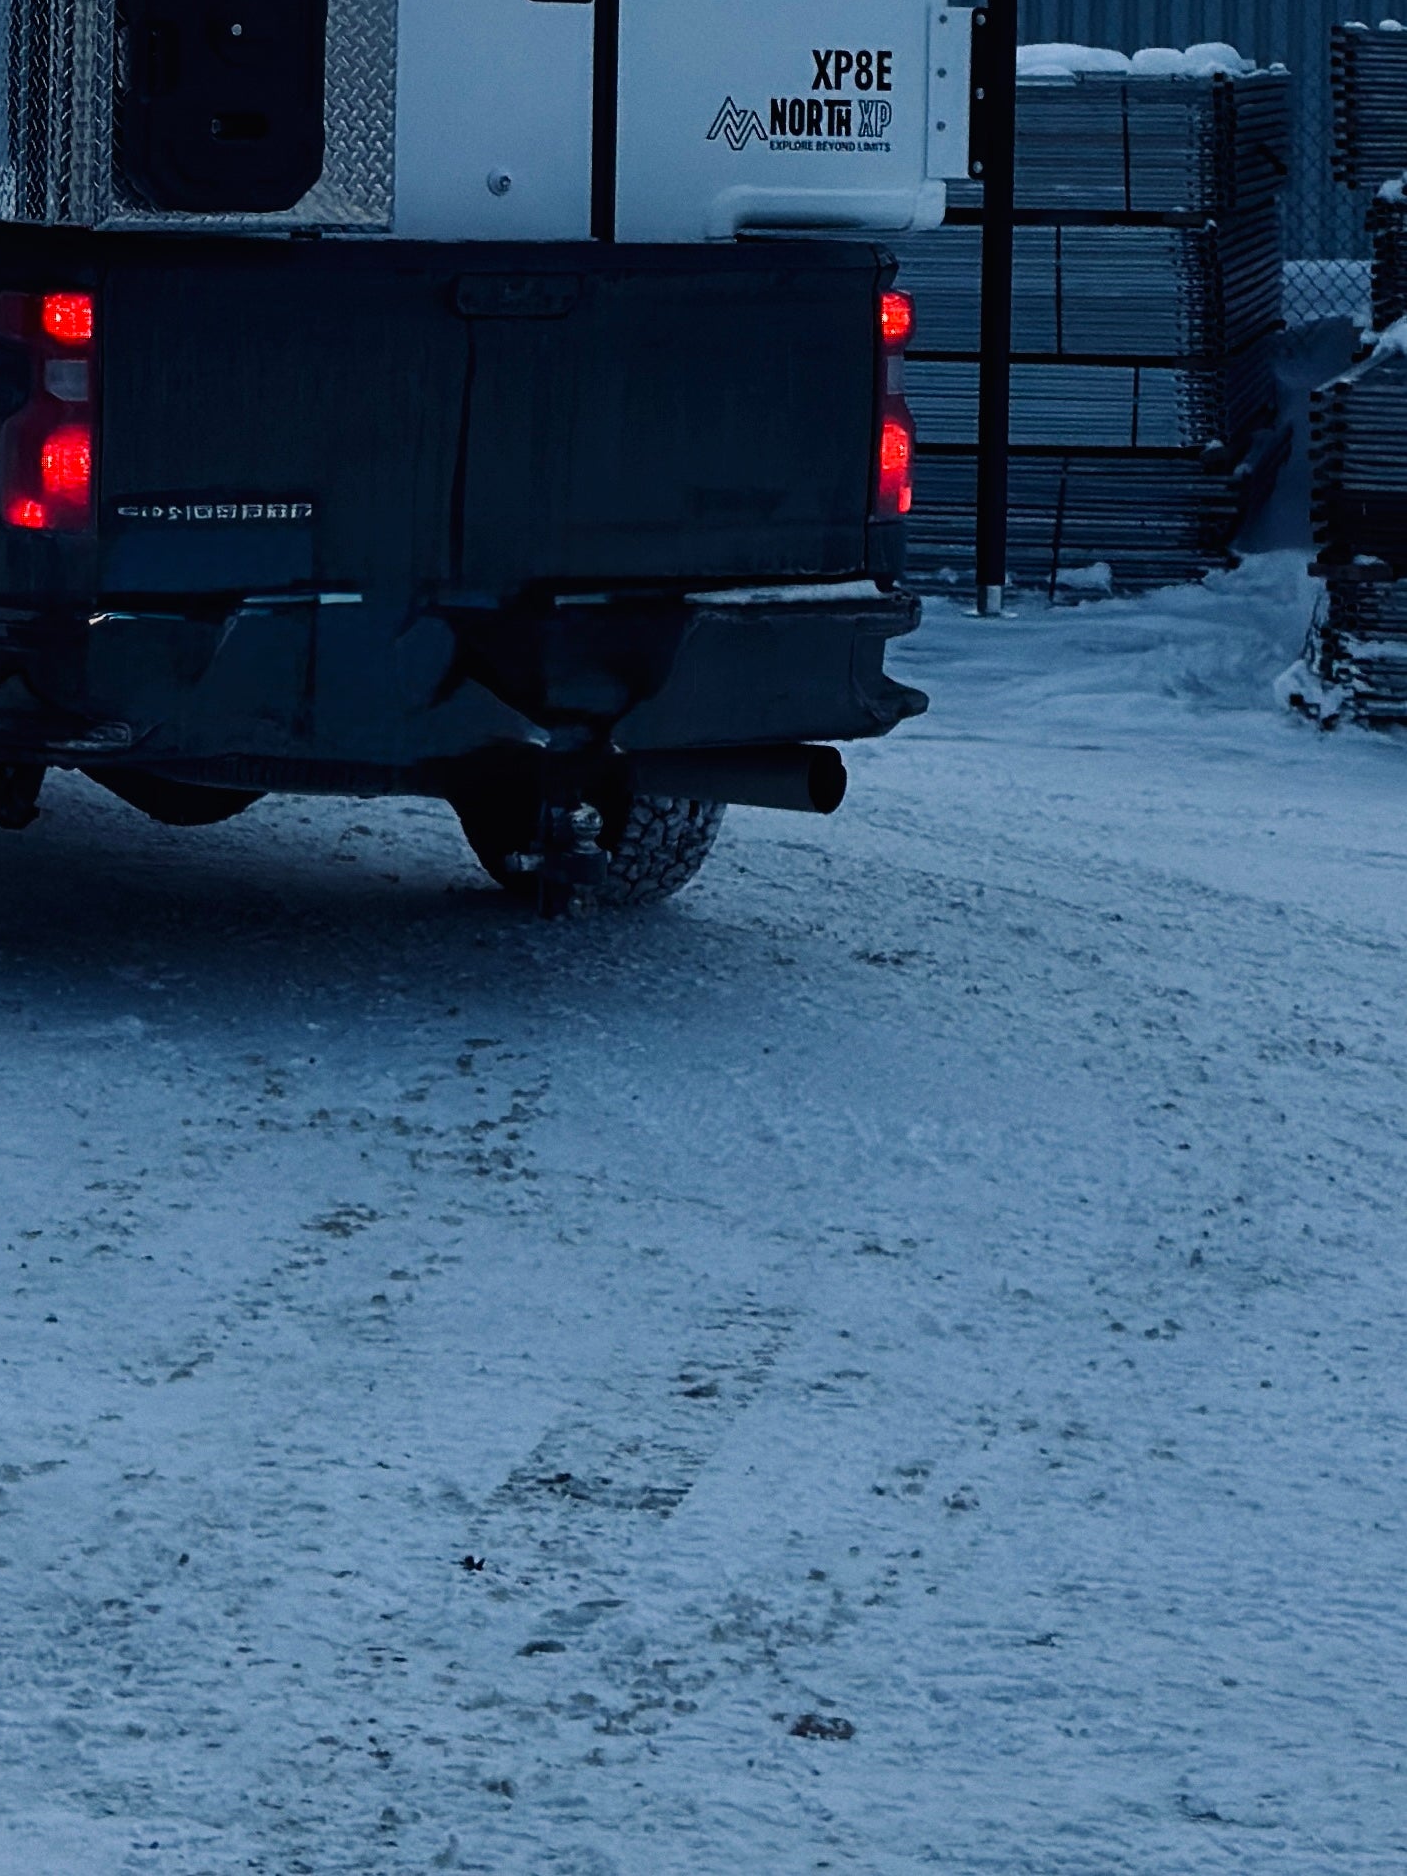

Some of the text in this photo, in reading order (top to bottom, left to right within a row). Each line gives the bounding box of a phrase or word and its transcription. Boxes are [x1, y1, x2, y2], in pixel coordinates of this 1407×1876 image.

[812, 49, 892, 91] XP8E
[770, 98, 892, 137] NORTH XP
[770, 140, 813, 151] EXPLORE
[816, 141, 855, 151] BEYOND
